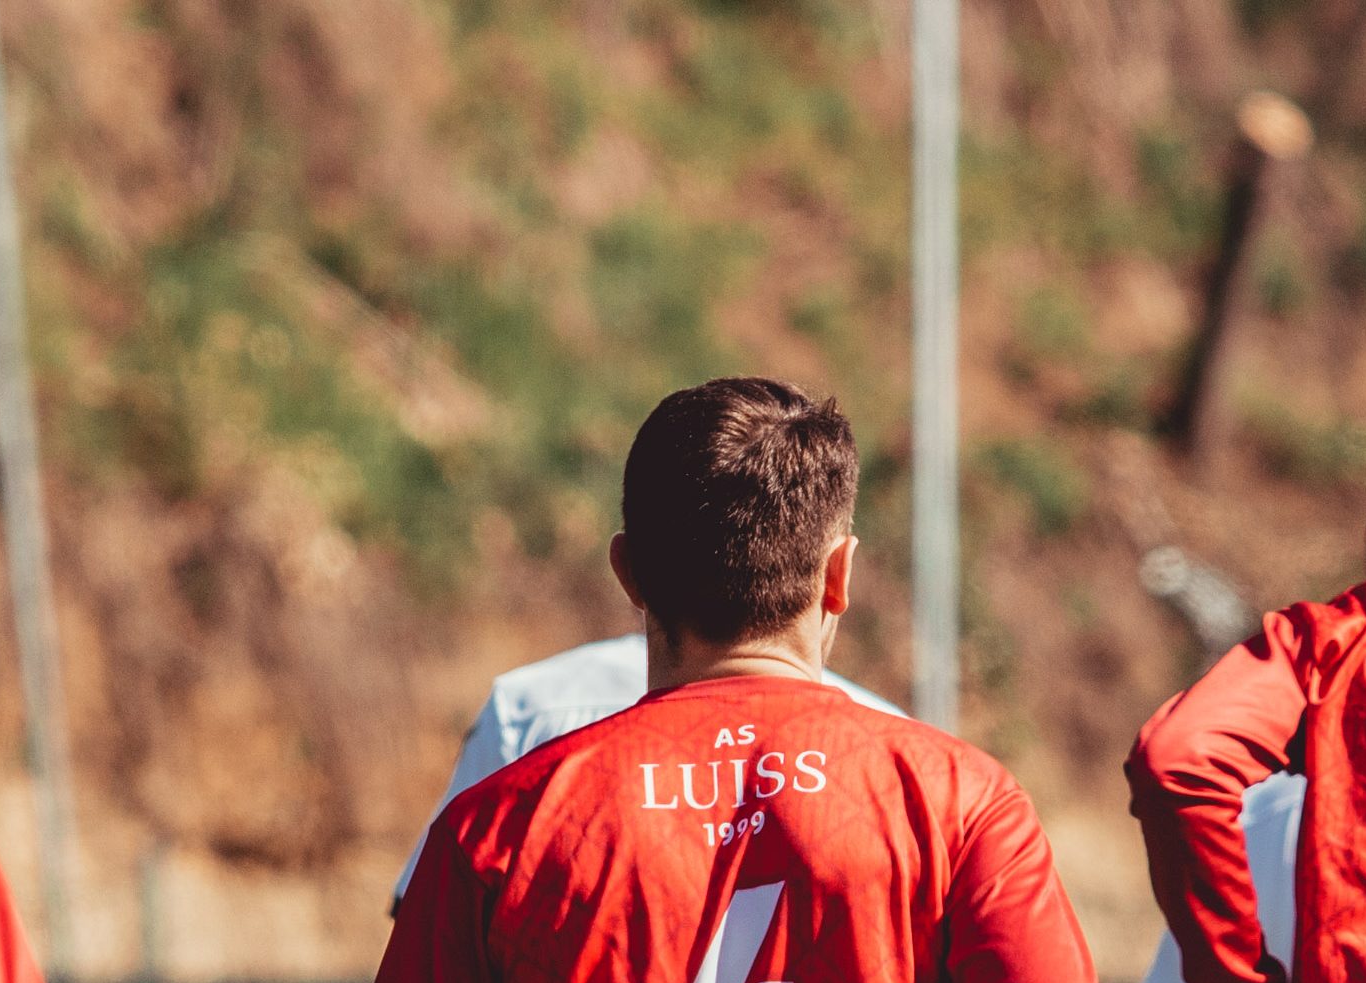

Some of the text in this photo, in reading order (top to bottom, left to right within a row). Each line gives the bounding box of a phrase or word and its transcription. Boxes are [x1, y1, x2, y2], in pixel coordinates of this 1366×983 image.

[714, 724, 756, 749] AS
[638, 750, 828, 810] LUISS
[702, 811, 766, 847] 1999
